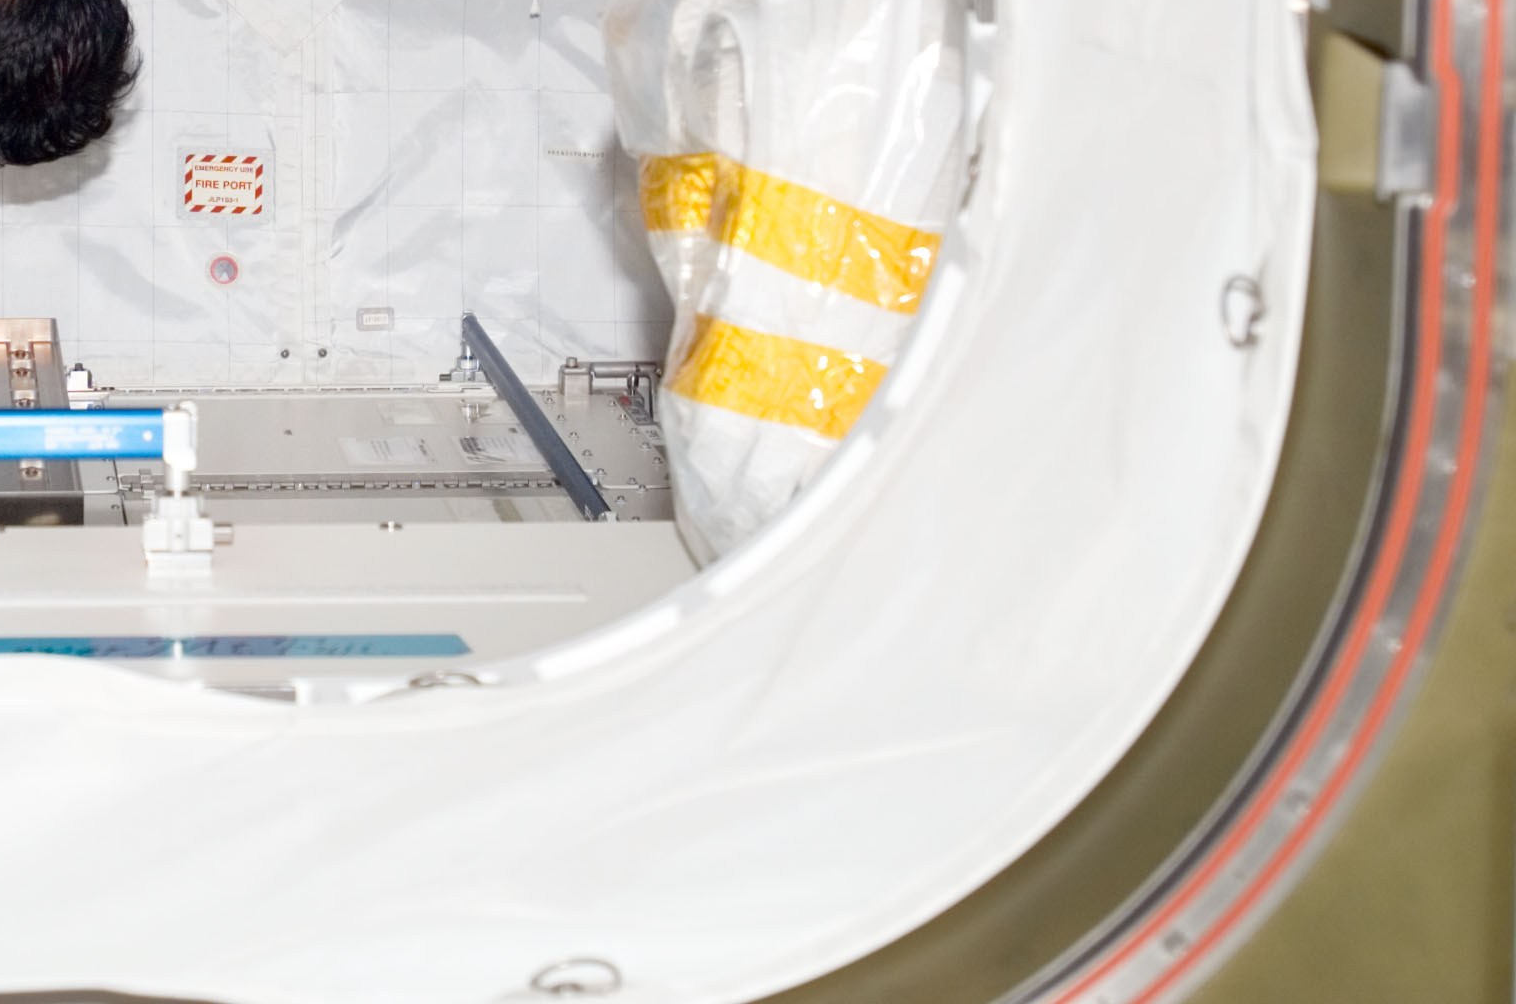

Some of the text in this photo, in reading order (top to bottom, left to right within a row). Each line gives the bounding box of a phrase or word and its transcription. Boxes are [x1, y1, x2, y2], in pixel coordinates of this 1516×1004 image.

[194, 165, 238, 173] EMERGENCY
[195, 179, 253, 191] FIRE PORT
